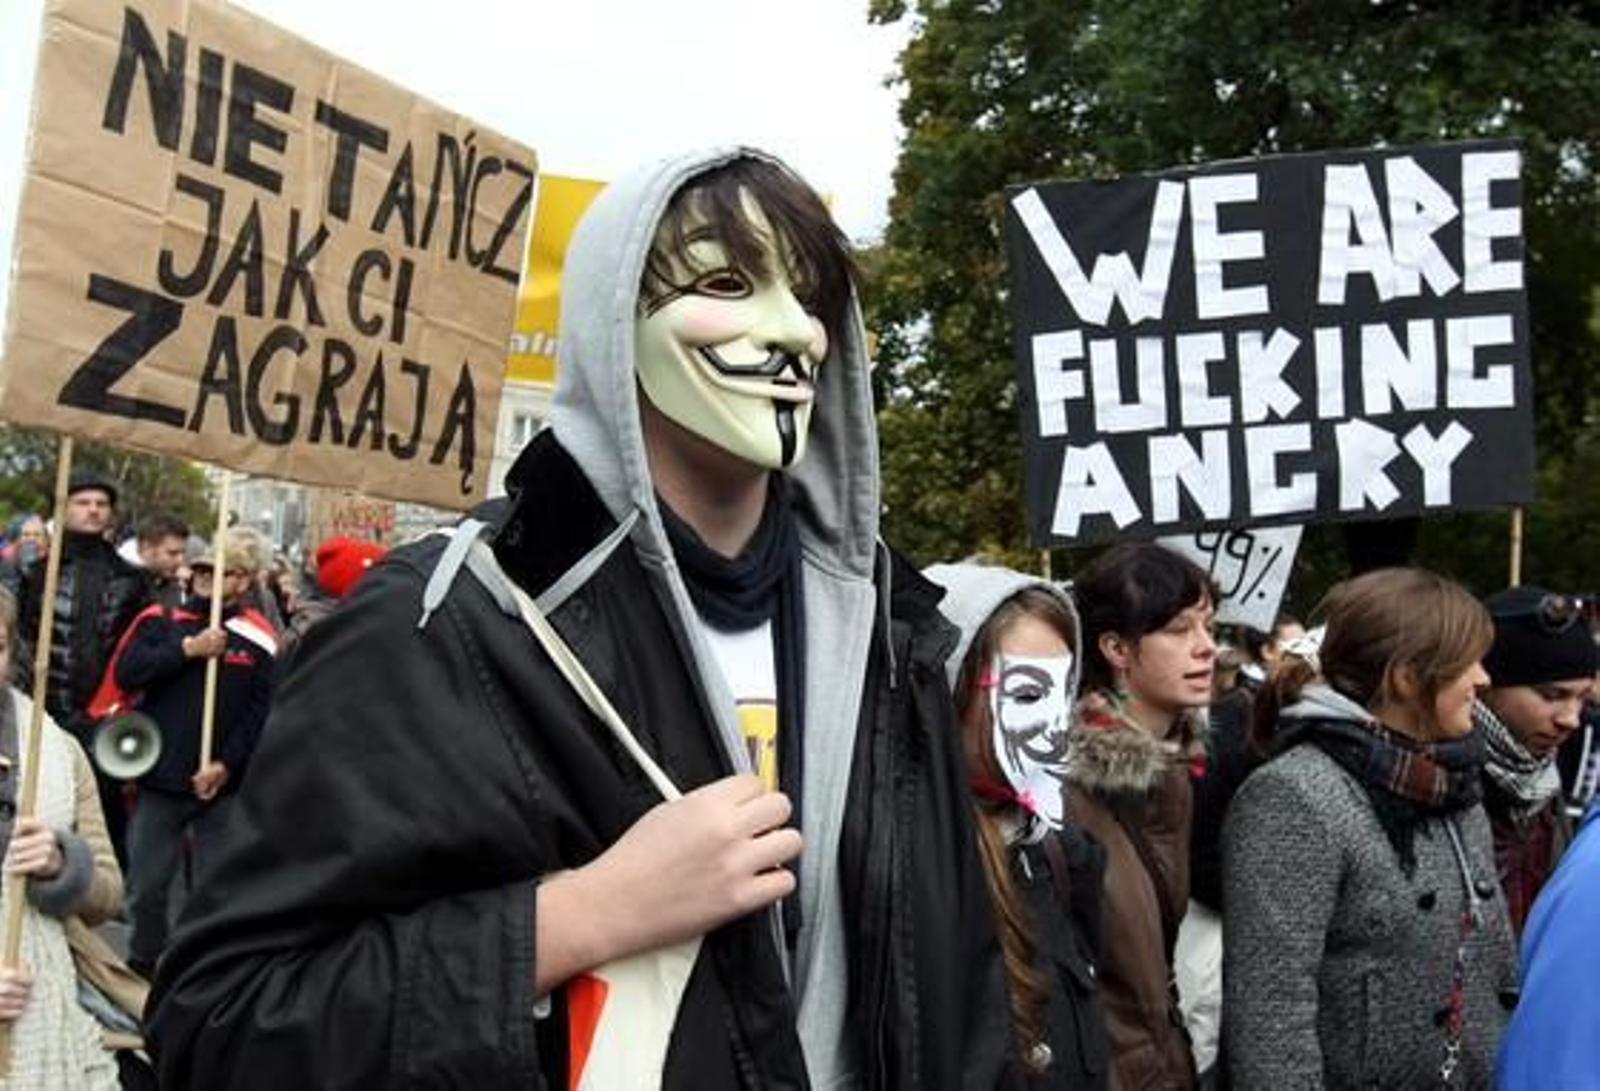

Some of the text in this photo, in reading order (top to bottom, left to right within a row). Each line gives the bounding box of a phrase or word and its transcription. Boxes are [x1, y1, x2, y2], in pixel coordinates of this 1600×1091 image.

[102, 6, 535, 284] NIE TAŃCZ
[157, 172, 414, 345] JAK CI
[1012, 150, 1524, 326] WE ARE
[57, 273, 476, 495] ZAGRAJĄ
[1032, 315, 1514, 436] FUCKING
[1051, 418, 1473, 537] ANGRY
